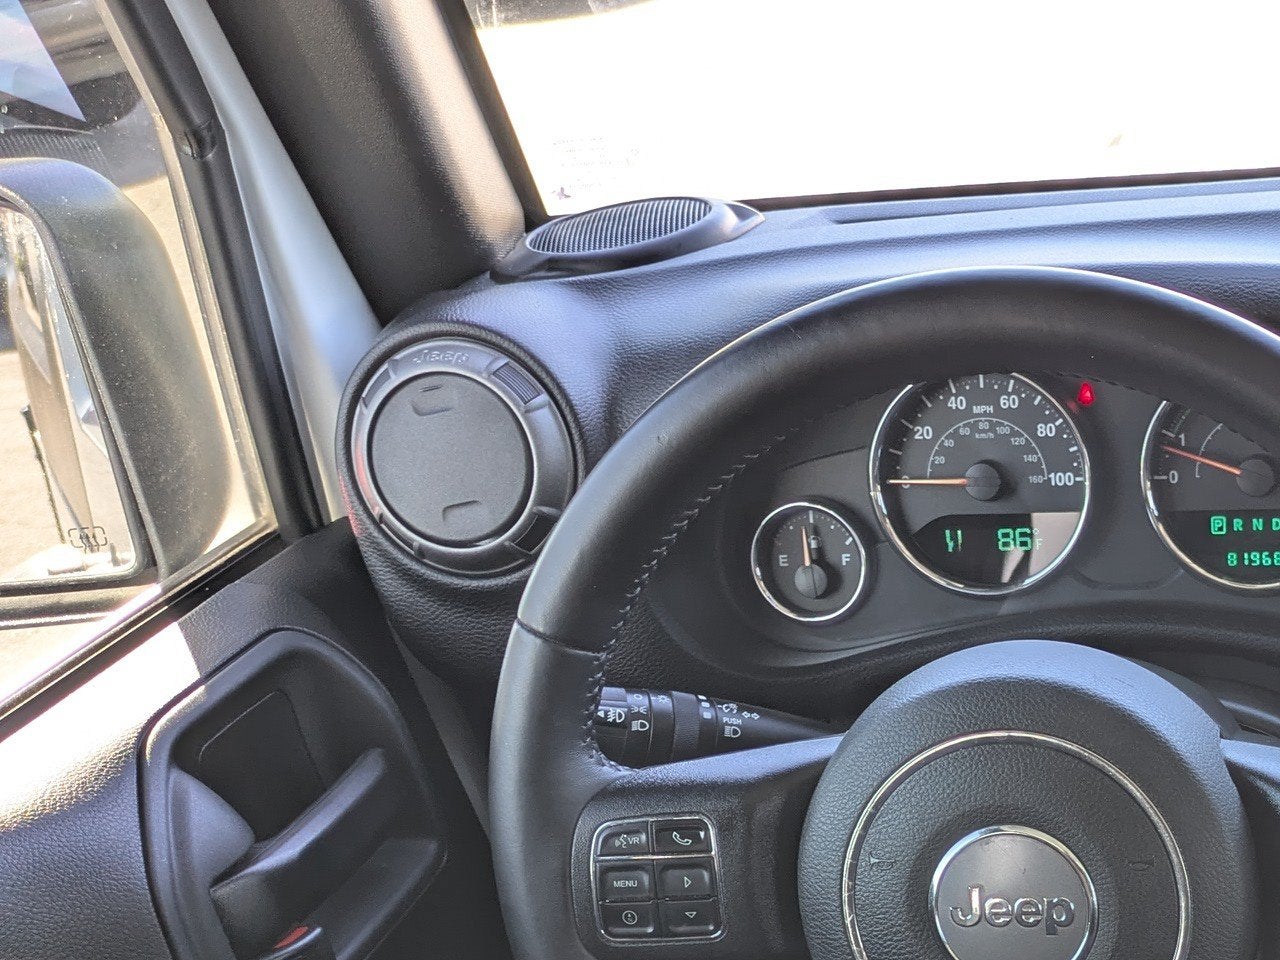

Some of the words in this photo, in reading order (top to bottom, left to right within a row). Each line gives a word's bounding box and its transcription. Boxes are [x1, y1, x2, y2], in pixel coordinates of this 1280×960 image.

[947, 397, 967, 410] 40
[1000, 395, 1019, 410] 60
[973, 405, 993, 414] MPH
[979, 421, 989, 430] 80
[996, 425, 1010, 435] 100
[1037, 423, 1056, 438] 80
[914, 427, 933, 440] 20
[959, 427, 970, 436] 60
[975, 431, 994, 440] km/h
[943, 438, 954, 448] 40
[1010, 437, 1025, 446] 120
[1178, 433, 1185, 447] 1
[934, 455, 945, 465] 20
[1023, 454, 1038, 463] 140
[1028, 475, 1043, 484] 160
[1049, 472, 1075, 487] 100
[1169, 470, 1179, 484] 0
[1233, 518, 1243, 531] R
[1252, 518, 1263, 531] N
[779, 555, 788, 567] E
[842, 554, 850, 566] F
[723, 717, 742, 725] PUSH
[628, 836, 639, 844] VR
[613, 880, 638, 888] MENU
[949, 884, 1075, 936] Jeep
